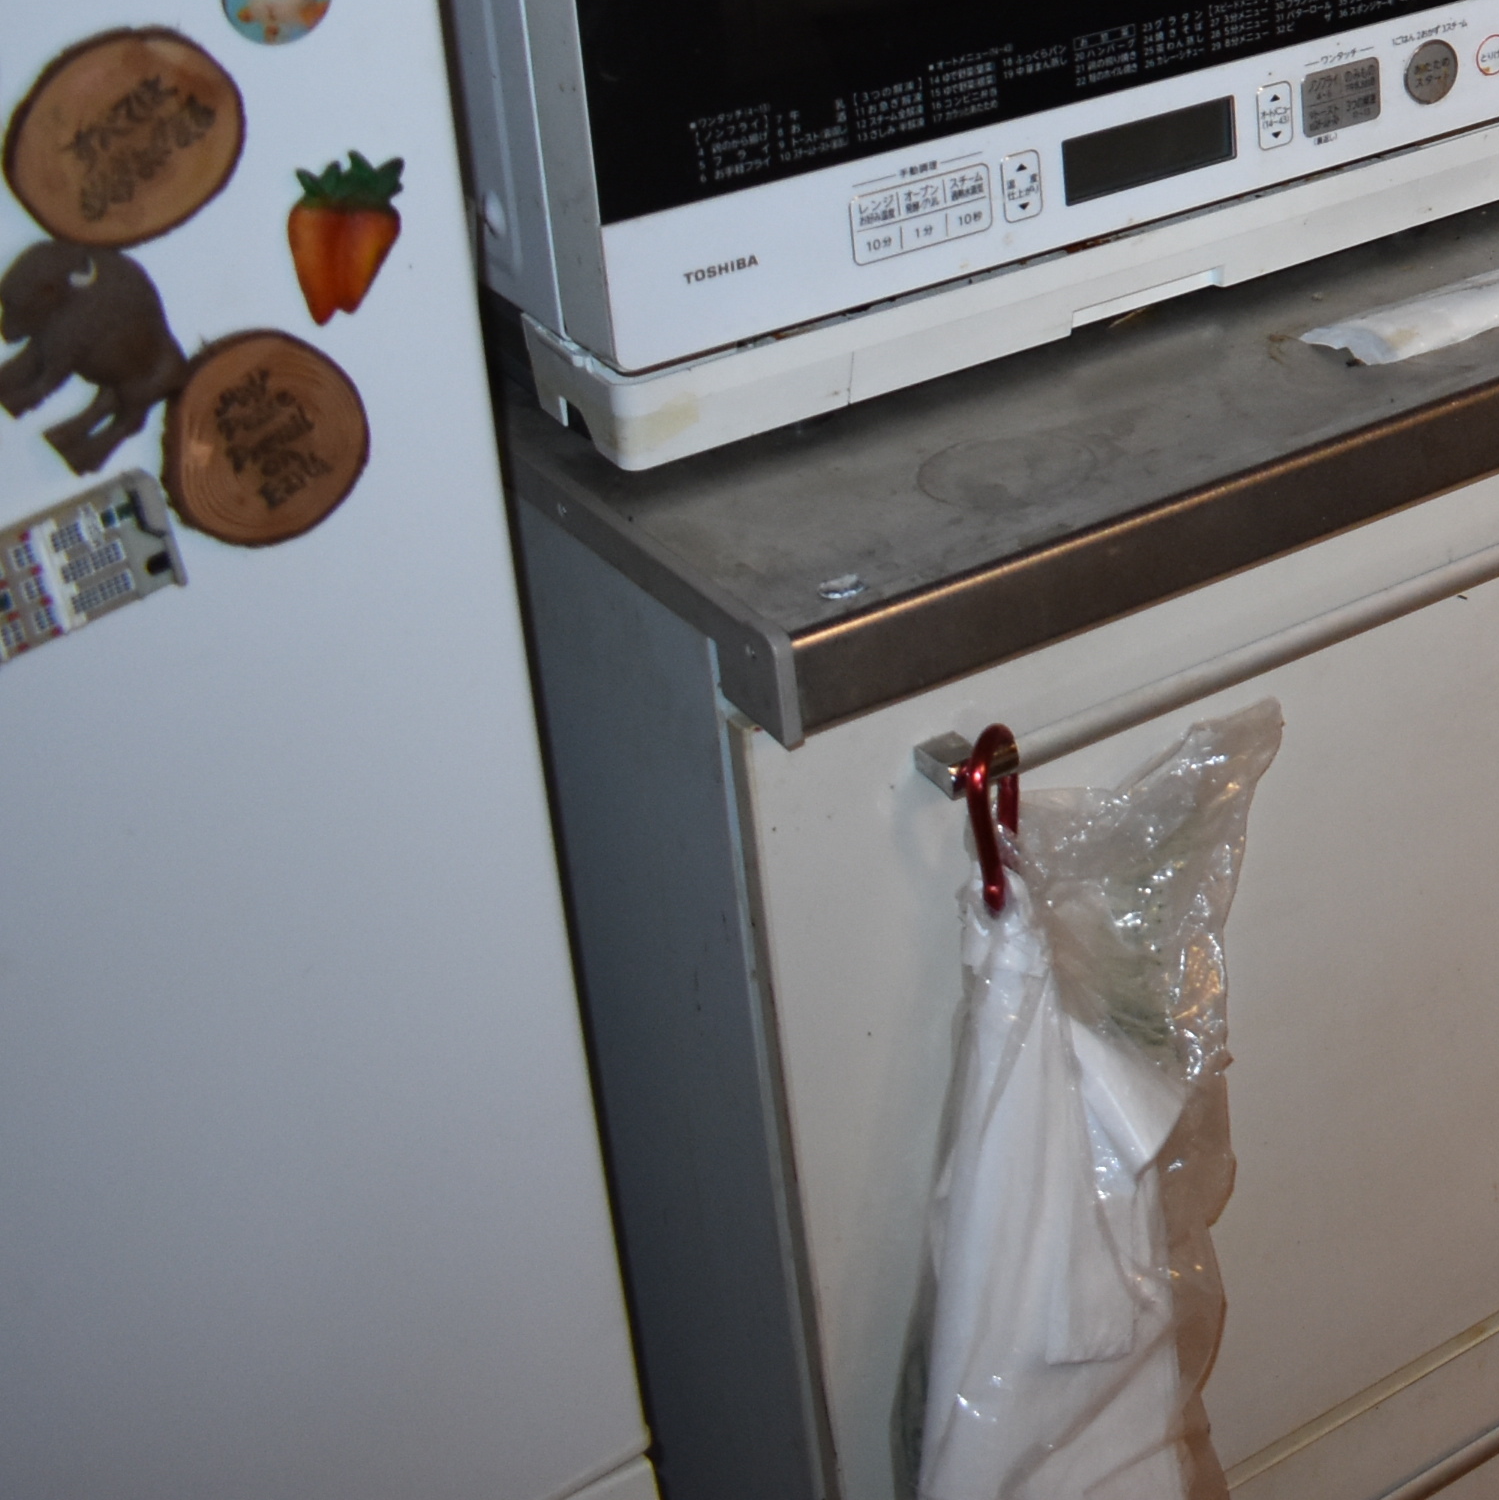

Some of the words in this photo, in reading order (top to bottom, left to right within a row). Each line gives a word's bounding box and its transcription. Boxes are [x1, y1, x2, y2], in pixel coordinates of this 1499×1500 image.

[899, 160, 938, 178] 手動調理
[950, 172, 984, 189] スチーム
[904, 185, 939, 201] オーブン
[859, 195, 895, 215] レンジ
[683, 254, 759, 285] TOSHIBA
